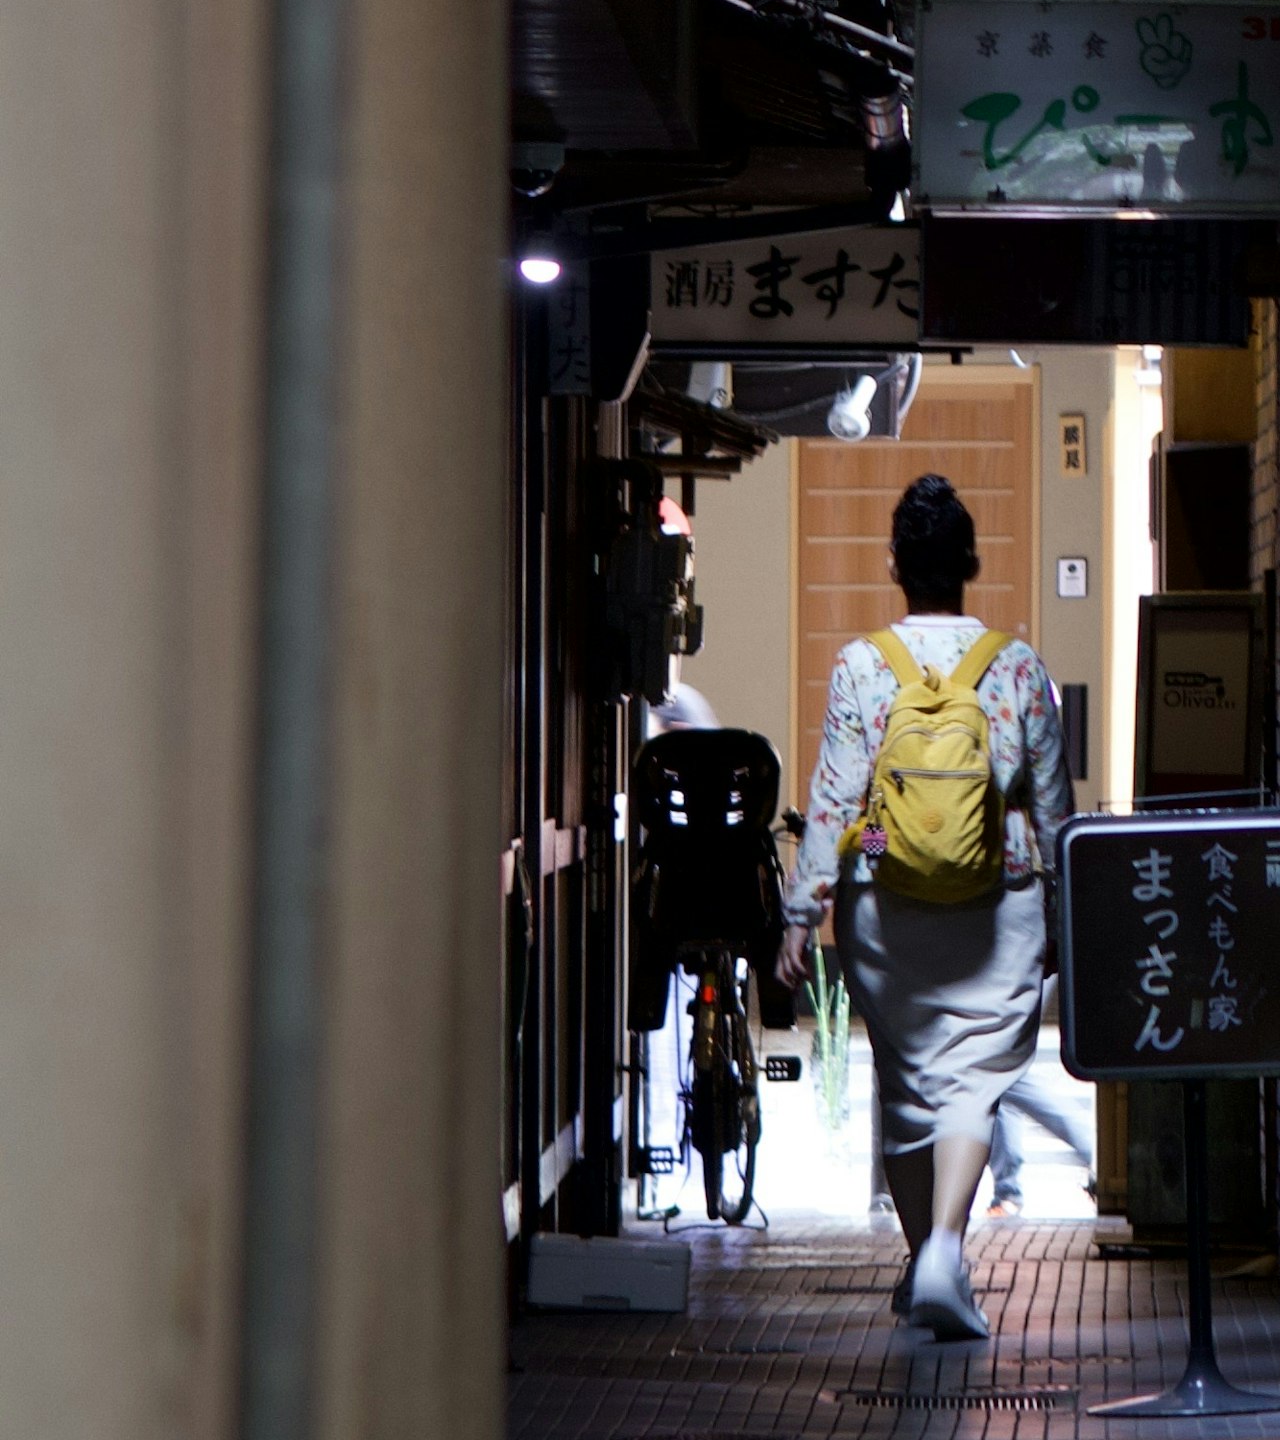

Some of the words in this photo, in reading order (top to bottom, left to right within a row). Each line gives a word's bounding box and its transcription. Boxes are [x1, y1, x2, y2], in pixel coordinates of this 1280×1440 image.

[665, 259, 735, 308] 酒房
[1201, 842, 1243, 1032] 食べもん家
